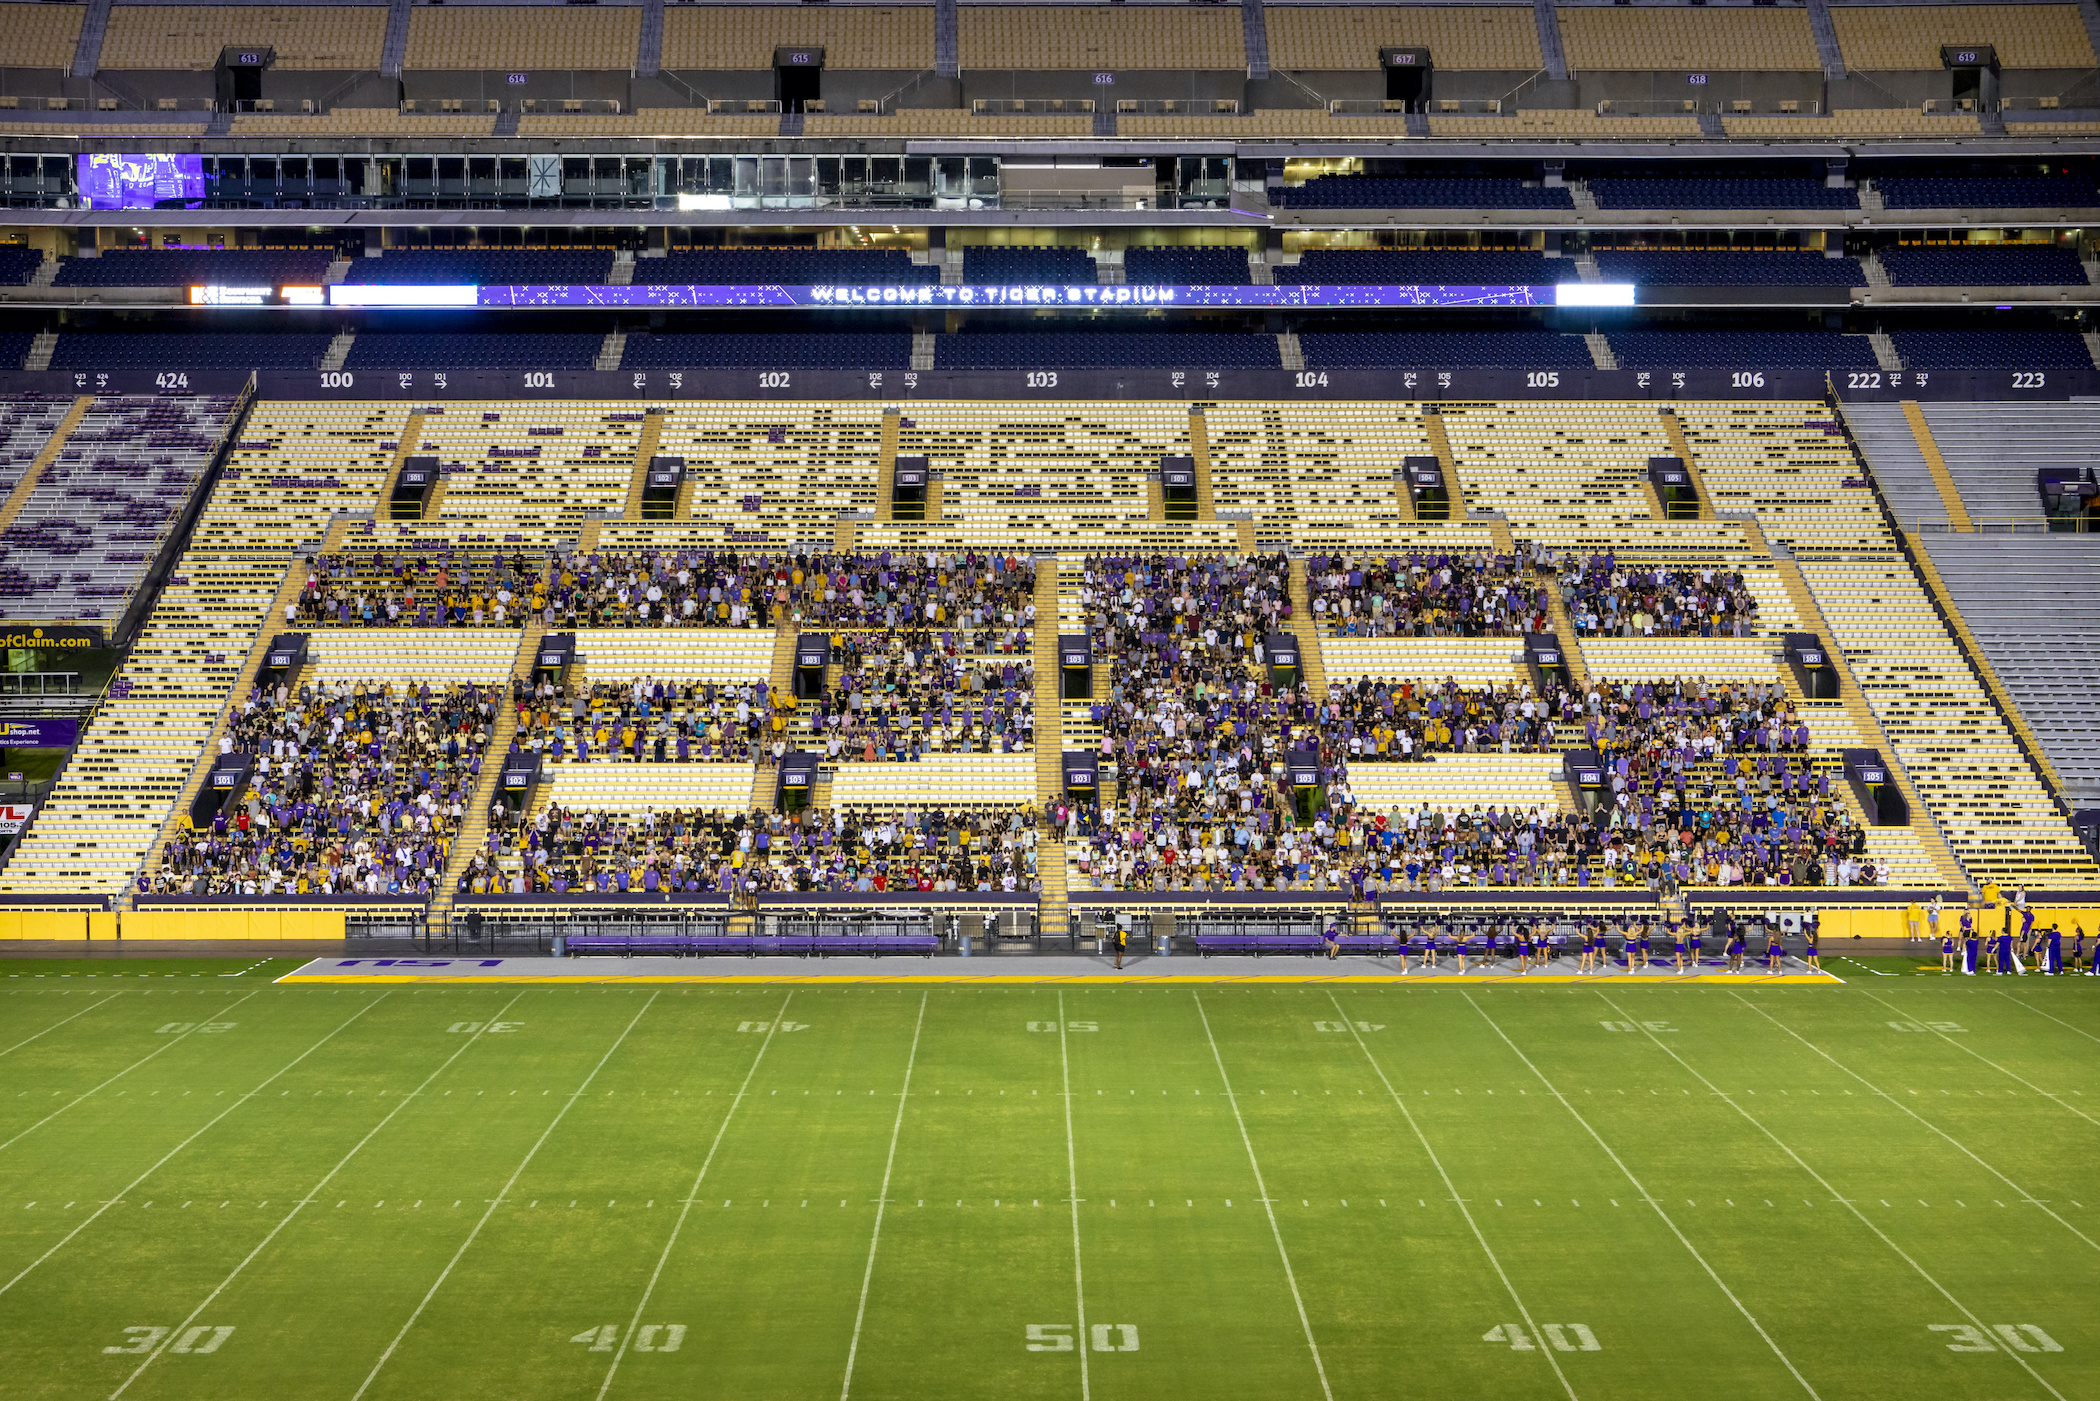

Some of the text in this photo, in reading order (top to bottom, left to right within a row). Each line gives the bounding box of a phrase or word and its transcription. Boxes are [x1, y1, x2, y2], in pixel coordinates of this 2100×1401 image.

[241, 53, 258, 63] 613
[792, 53, 809, 63] 615
[1395, 54, 1413, 64] 617
[1958, 52, 1976, 62] 619
[508, 74, 526, 84] 614
[1095, 74, 1113, 84] 616
[1689, 74, 1706, 84] 618
[811, 287, 1175, 302] WELCOME TO TIGER STADIUM
[155, 372, 189, 388] 424
[320, 372, 354, 388] 100
[524, 372, 555, 388] 101
[759, 372, 791, 388] 102
[1026, 372, 1058, 388] 103
[1171, 372, 1185, 380] 103
[1206, 372, 1219, 380] 104
[1295, 372, 1329, 388] 104
[1403, 372, 1417, 380] 104
[1438, 372, 1452, 380] 105
[1527, 372, 1559, 388] 105
[1637, 372, 1650, 380] 105
[1672, 372, 1686, 380] 106
[1732, 372, 1765, 388] 106
[1847, 372, 1881, 388] 222
[2012, 372, 2046, 388] 223
[336, 959, 505, 967] LSU
[102, 1325, 236, 1355] 30
[568, 1324, 687, 1353] 40
[1025, 1324, 1140, 1353] 50
[1481, 1323, 1602, 1352] 40
[1926, 1323, 2065, 1353] 30
